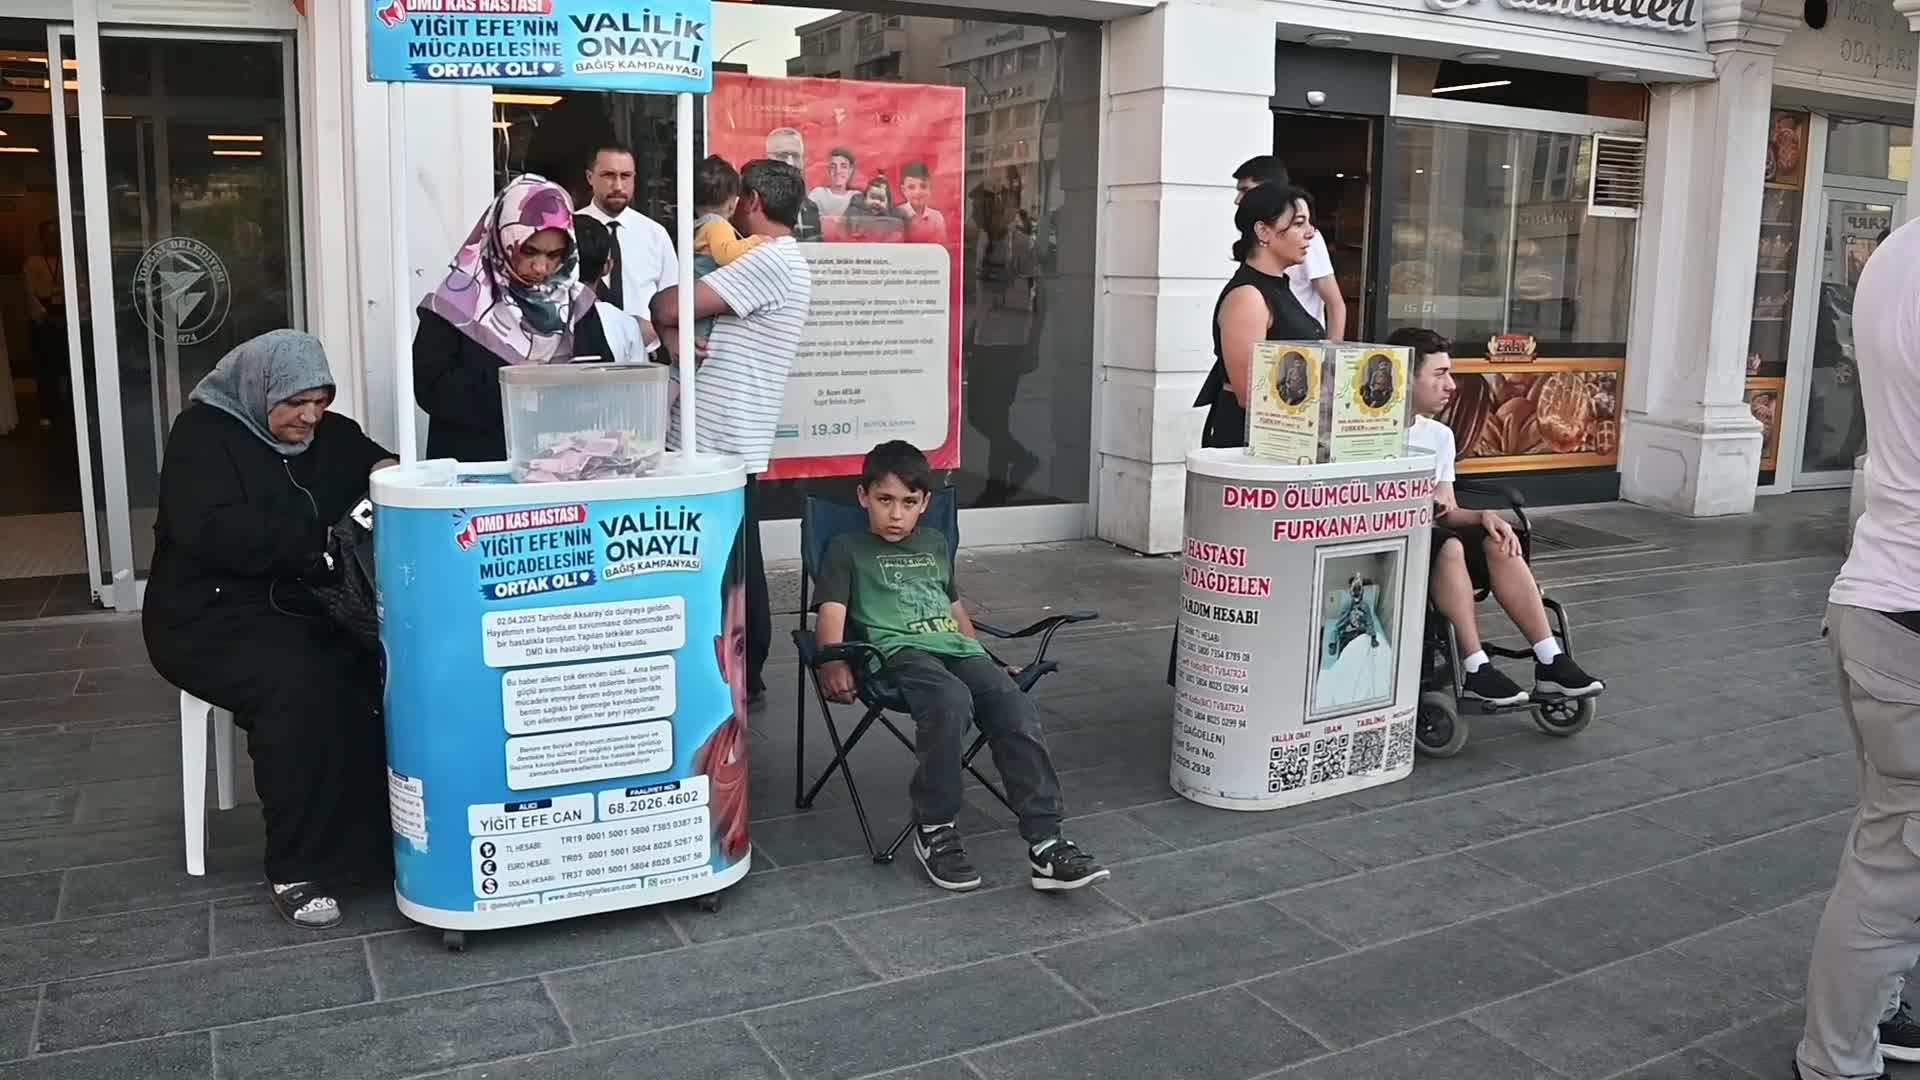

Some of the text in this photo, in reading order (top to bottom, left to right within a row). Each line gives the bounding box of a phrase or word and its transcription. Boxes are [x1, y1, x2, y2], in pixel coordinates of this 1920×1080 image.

[411, 14, 558, 36] YİĞİT EFE'NİN
[568, 8, 706, 41] VALİLİK
[409, 38, 562, 57] MÜCADELESİNE
[577, 37, 700, 63] ONAYLI
[427, 62, 539, 77] ORTAK OL!
[575, 60, 702, 77] BAĞIŞ KAMPANYASI
[811, 423, 851, 436] 19.30
[1224, 487, 1277, 508] DMD
[1284, 481, 1371, 508] ÖLÜMCÜL
[1376, 481, 1407, 500] KAS
[476, 506, 579, 533] DMD KAS HASTASI
[598, 505, 703, 538] VALİLİK
[1274, 514, 1366, 540] FURKAN'A
[1373, 510, 1416, 532] UMUT
[480, 526, 592, 558] YİĞİT EFE'NİN
[606, 535, 698, 562] ONAYLI
[1188, 540, 1246, 566] HASTASI
[480, 549, 595, 579] MÜCADELESİNE
[604, 559, 700, 578] BAĞIŞ KAMPANYASI
[494, 572, 578, 598] ORTAK OL!
[1191, 567, 1270, 596] DAĞDELEN
[1213, 605, 1259, 624] HESABI
[608, 790, 698, 815] 68.2026.4602
[480, 809, 581, 832] YİĞİT EFE CAN
[560, 835, 582, 845] TR19
